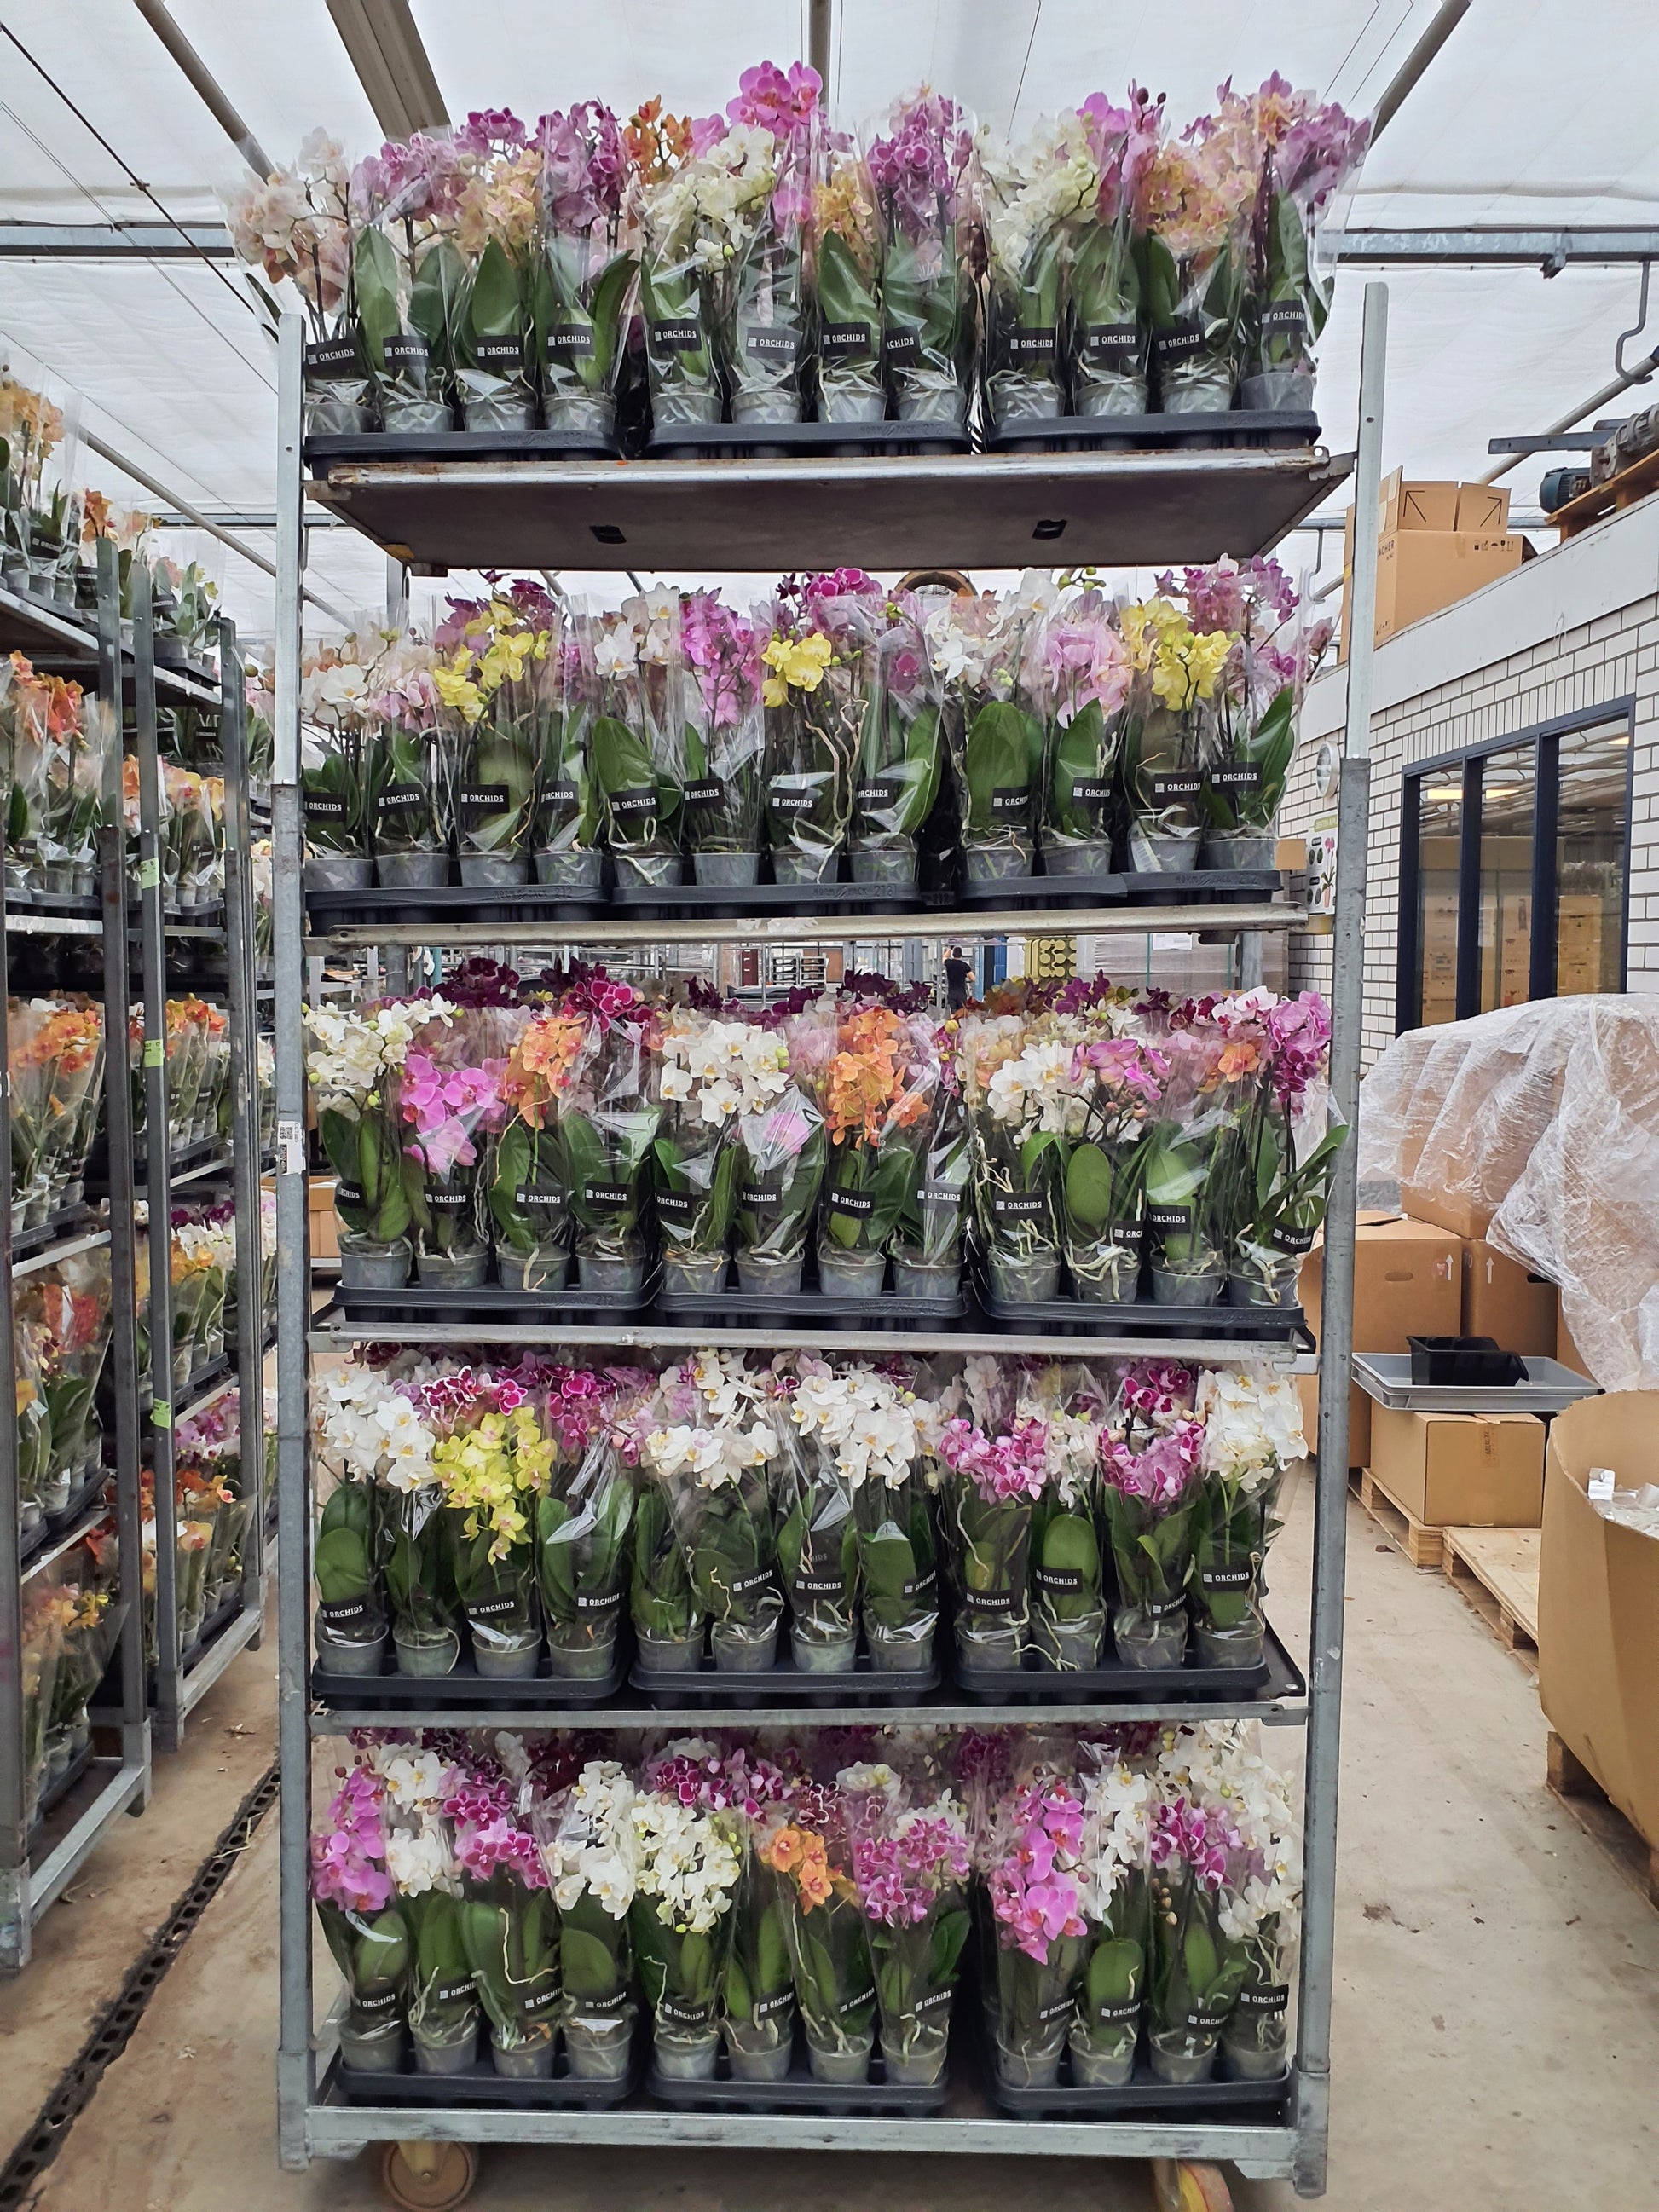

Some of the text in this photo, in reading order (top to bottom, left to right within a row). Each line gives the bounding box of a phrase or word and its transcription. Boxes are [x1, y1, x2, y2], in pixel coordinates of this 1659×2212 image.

[663, 329, 697, 339] ORCHIDS
[832, 333, 865, 343] ORCHIDS
[1101, 334, 1136, 344] ORCHIDS
[557, 335, 590, 344] ORCHIDS
[760, 338, 795, 349] ORCHIDS
[1020, 338, 1054, 348] ORCHIDS
[1168, 334, 1200, 348] ORCHIDS
[319, 348, 355, 361] ORCHIDS
[394, 346, 428, 356] ORCHIDS
[487, 346, 519, 355] ORCHIDS
[1223, 771, 1257, 781] ORCHIDS
[1167, 783, 1200, 791] ORCHIDS
[691, 788, 720, 799] ORCHIDS
[387, 794, 419, 804] ORCHIDS
[621, 798, 656, 809] ORCHIDS
[782, 799, 812, 808] ORCHIDS
[309, 801, 342, 811] ORCHIDS
[434, 1194, 466, 1203] ORCHIDS
[528, 1194, 561, 1203] ORCHIDS
[595, 1190, 627, 1201] ORCHIDS
[746, 1192, 777, 1202] ORCHIDS
[927, 1191, 961, 1201] ORCHIDS
[657, 1196, 688, 1208] ORCHIDS
[840, 1196, 870, 1208] ORCHIDS
[1007, 1200, 1042, 1209] ORCHIDS
[1153, 1214, 1185, 1223] ORCHIDS
[1126, 1229, 1142, 1238] ORC
[1285, 1234, 1312, 1245] ORCHIDS
[744, 1570, 772, 1588] ORCHIDS
[1043, 1575, 1078, 1585] ORCHIDS
[1215, 1571, 1250, 1581] ORCHIDS
[807, 1581, 841, 1590] ORCHIDS
[589, 1593, 620, 1607] ORCHIDS
[976, 1597, 1010, 1607] ORCHIDS
[329, 1604, 363, 1617] ORCHIDS
[479, 1601, 514, 1613] ORCHIDS
[362, 1994, 396, 2008] ORCHIDS
[597, 1991, 627, 2008] ORCHIDS
[924, 1990, 951, 2007] ORCHIDS
[1252, 1994, 1285, 2003] ORCHIDS
[673, 2009, 705, 2019] ORCHIDS
